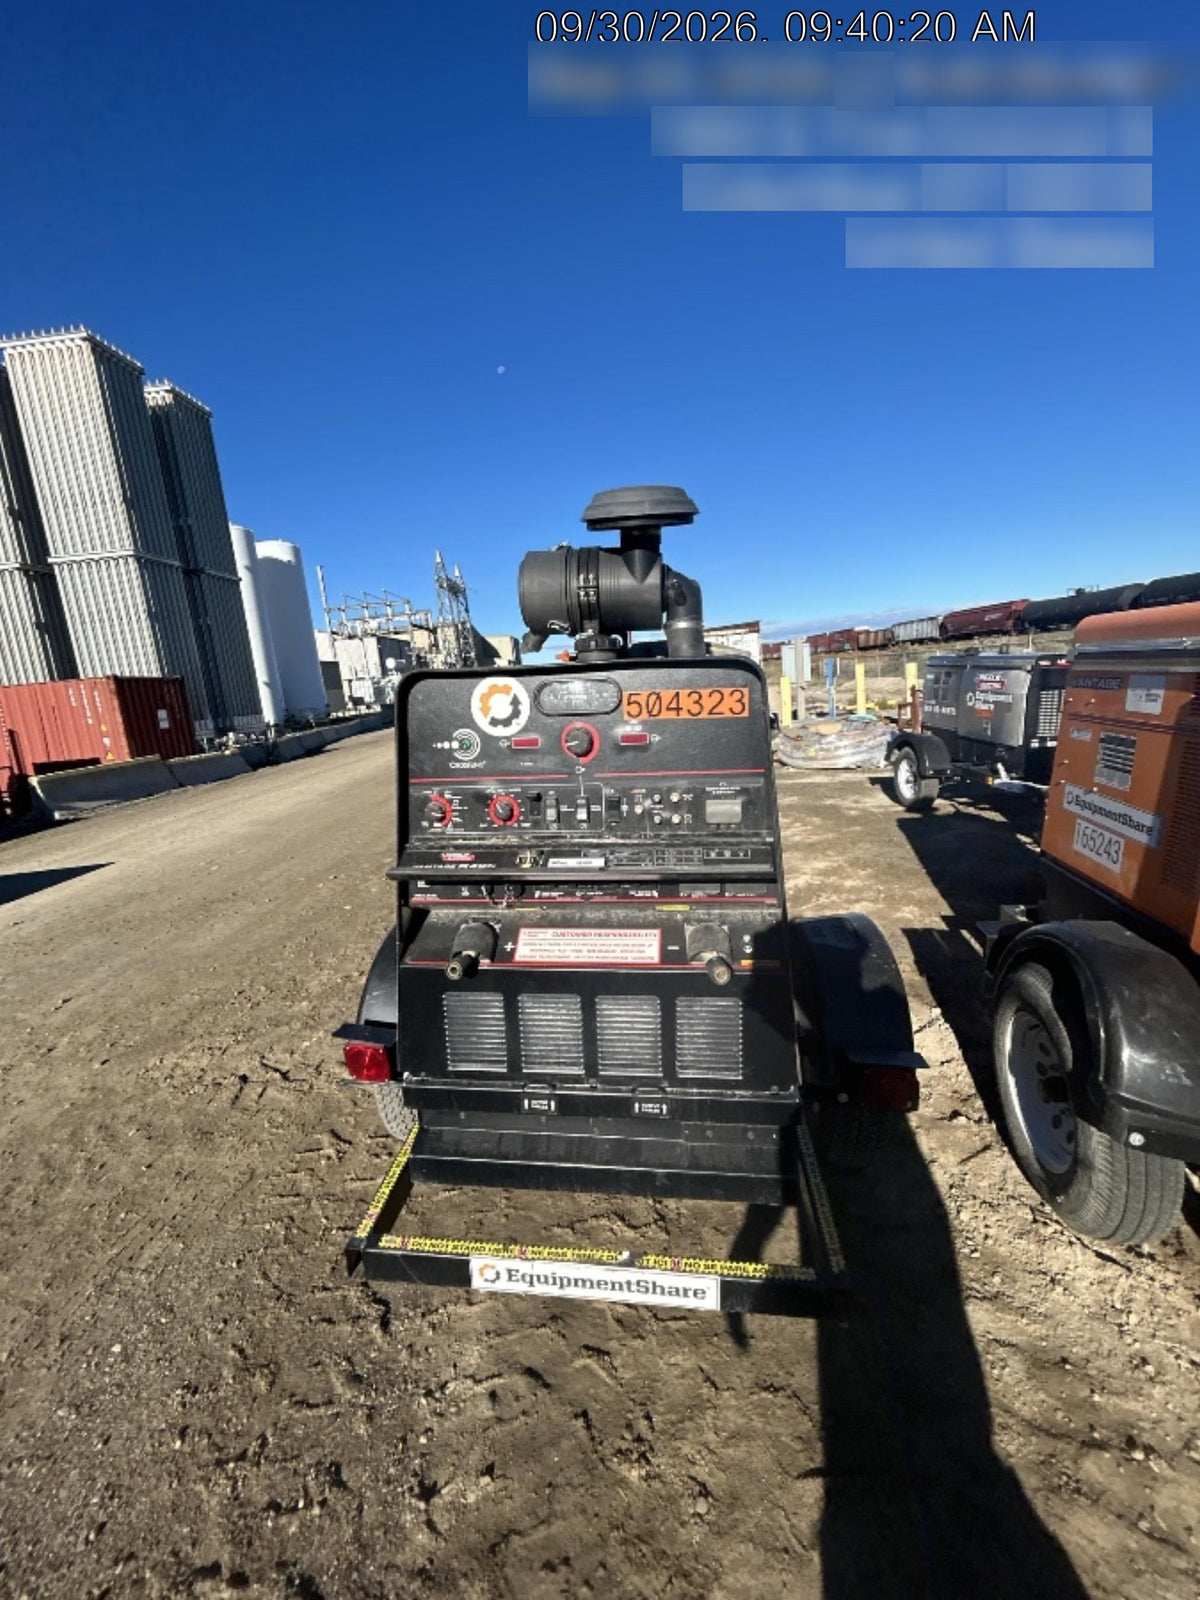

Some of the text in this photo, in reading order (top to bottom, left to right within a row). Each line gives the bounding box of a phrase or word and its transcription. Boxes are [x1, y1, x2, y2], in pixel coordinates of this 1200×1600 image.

[627, 689, 746, 718] 504323
[1074, 794, 1153, 836] EquipmentShare
[506, 1267, 707, 1300] EquipmentShare
